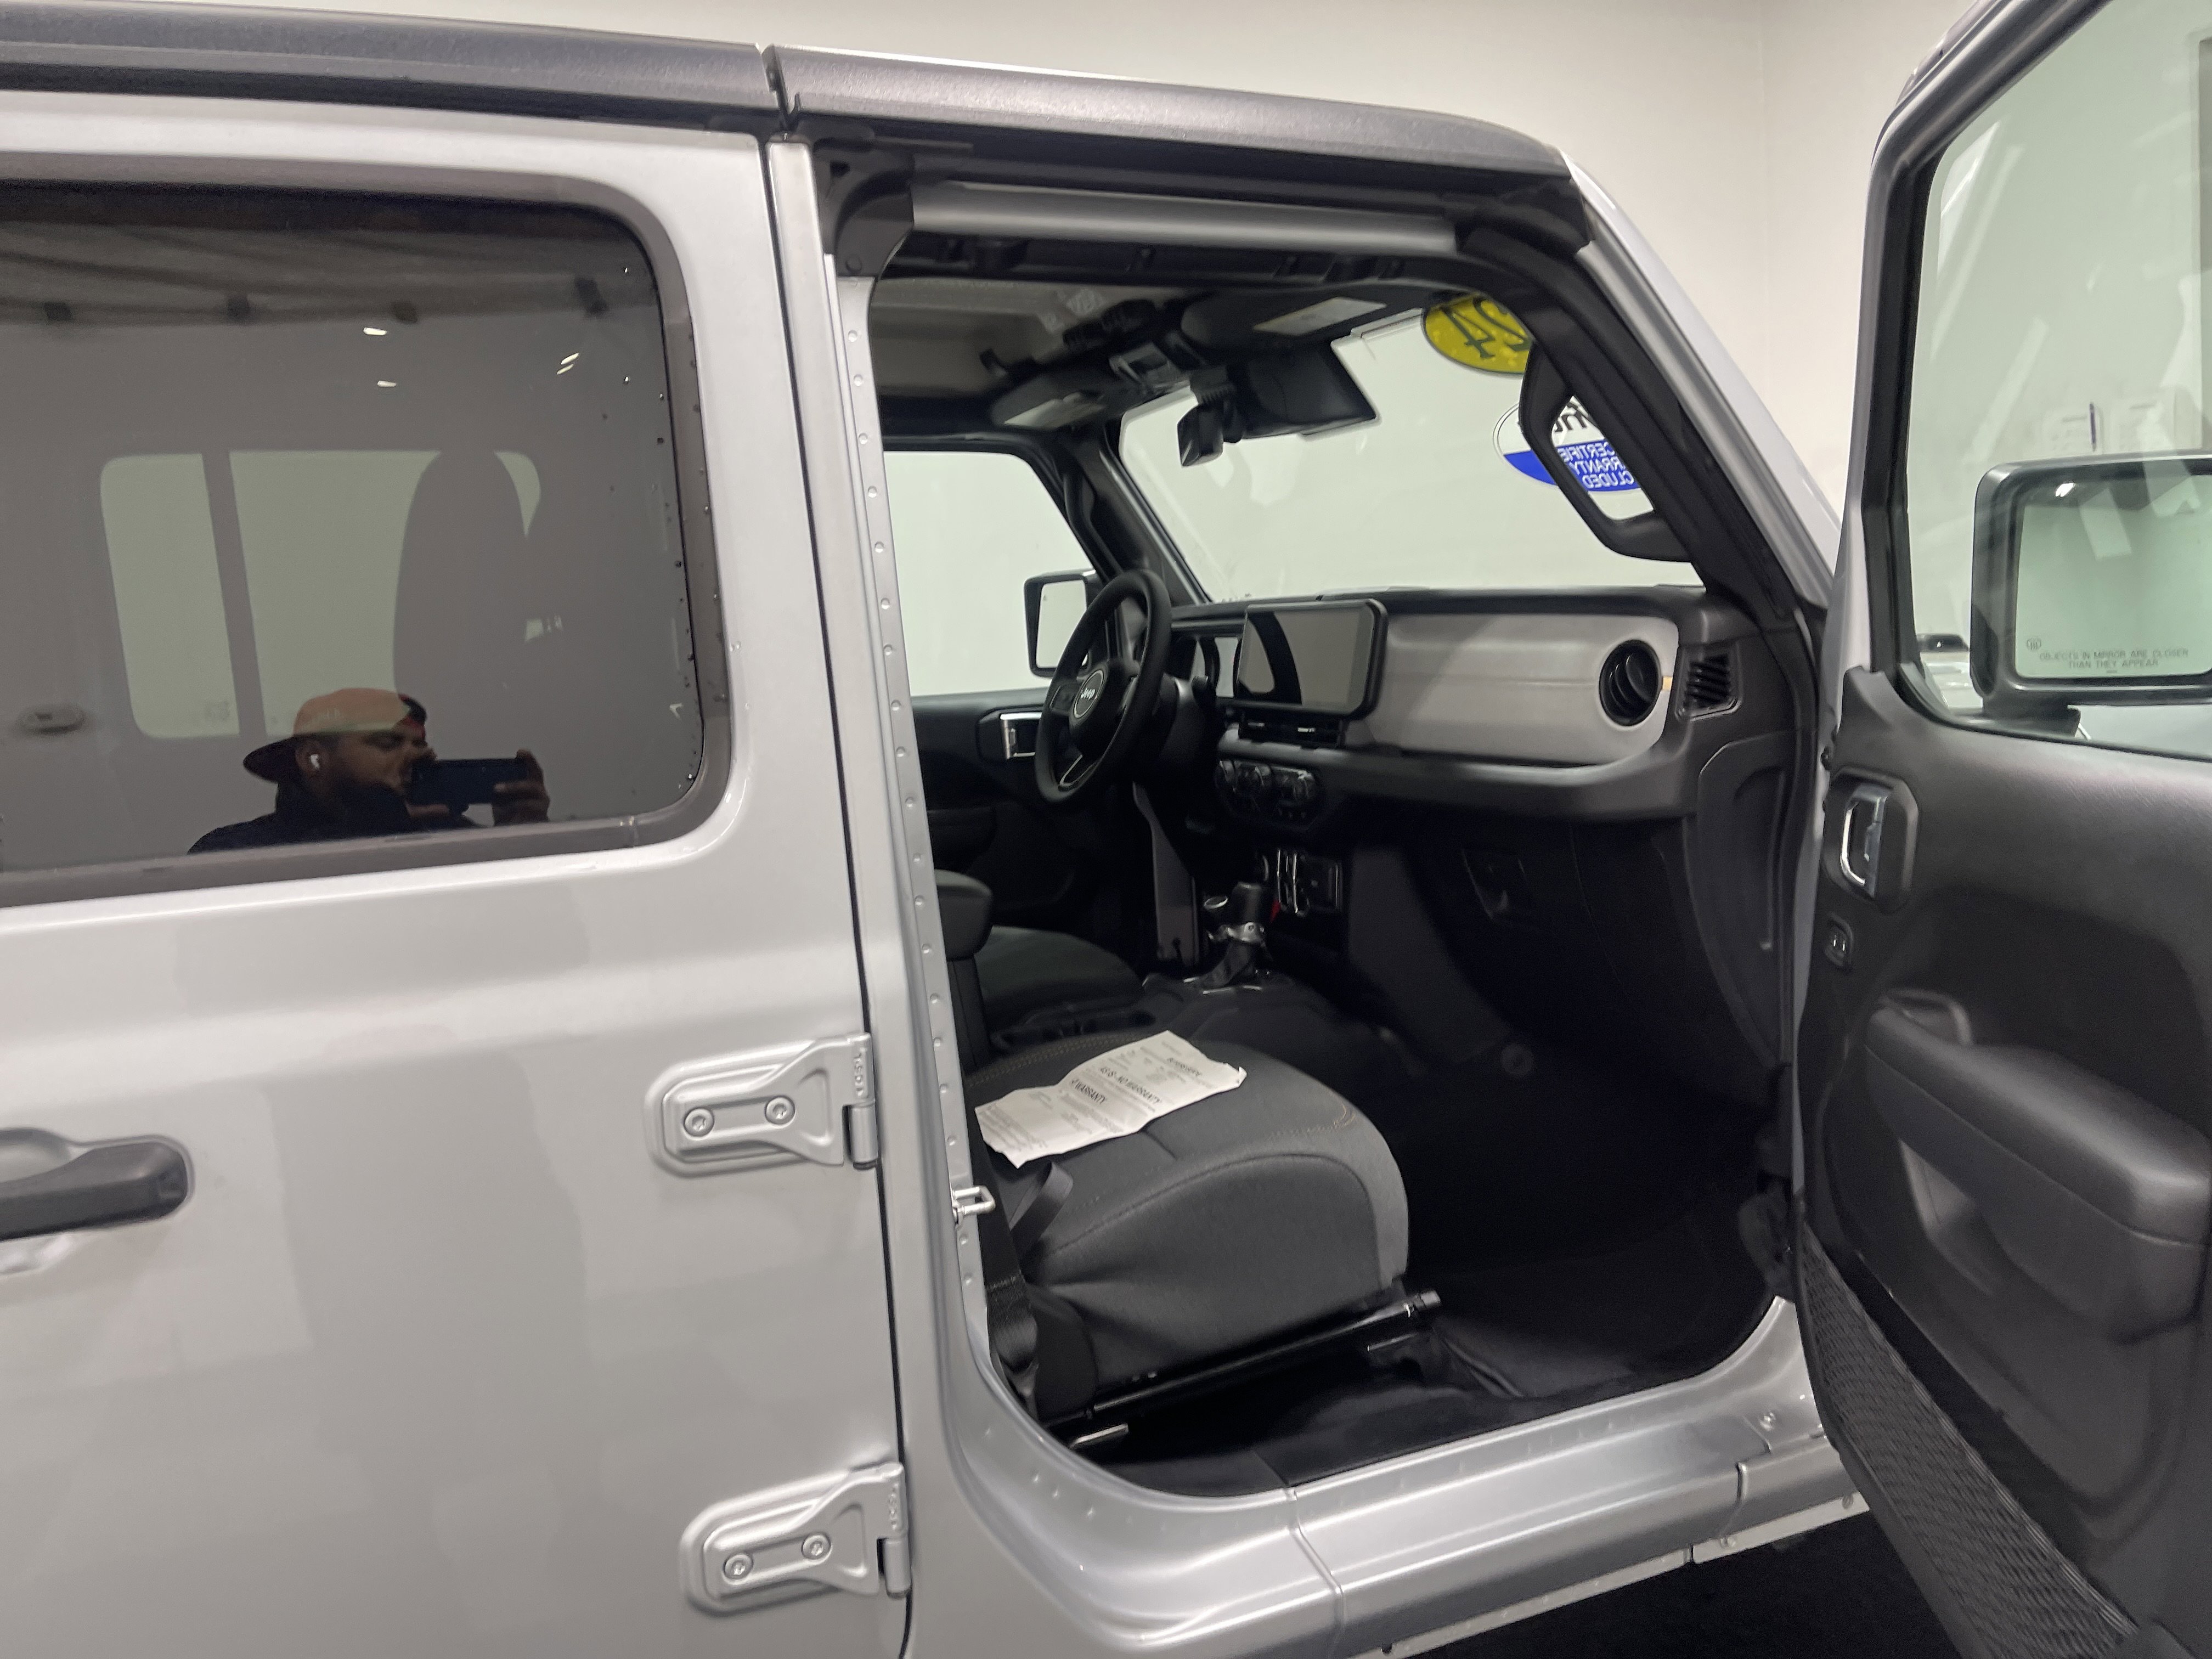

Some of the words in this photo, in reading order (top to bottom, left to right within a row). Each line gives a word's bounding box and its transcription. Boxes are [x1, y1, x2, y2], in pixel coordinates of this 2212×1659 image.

[2040, 651, 2078, 662] OBJECTS
[2094, 650, 2125, 658] MIRROR
[2131, 650, 2147, 658] ARE
[2153, 648, 2188, 658] CLOSER
[2096, 660, 2117, 668] THEY
[1081, 687, 1096, 700] Jeep
[1074, 1080, 1106, 1104] WARRANTY
